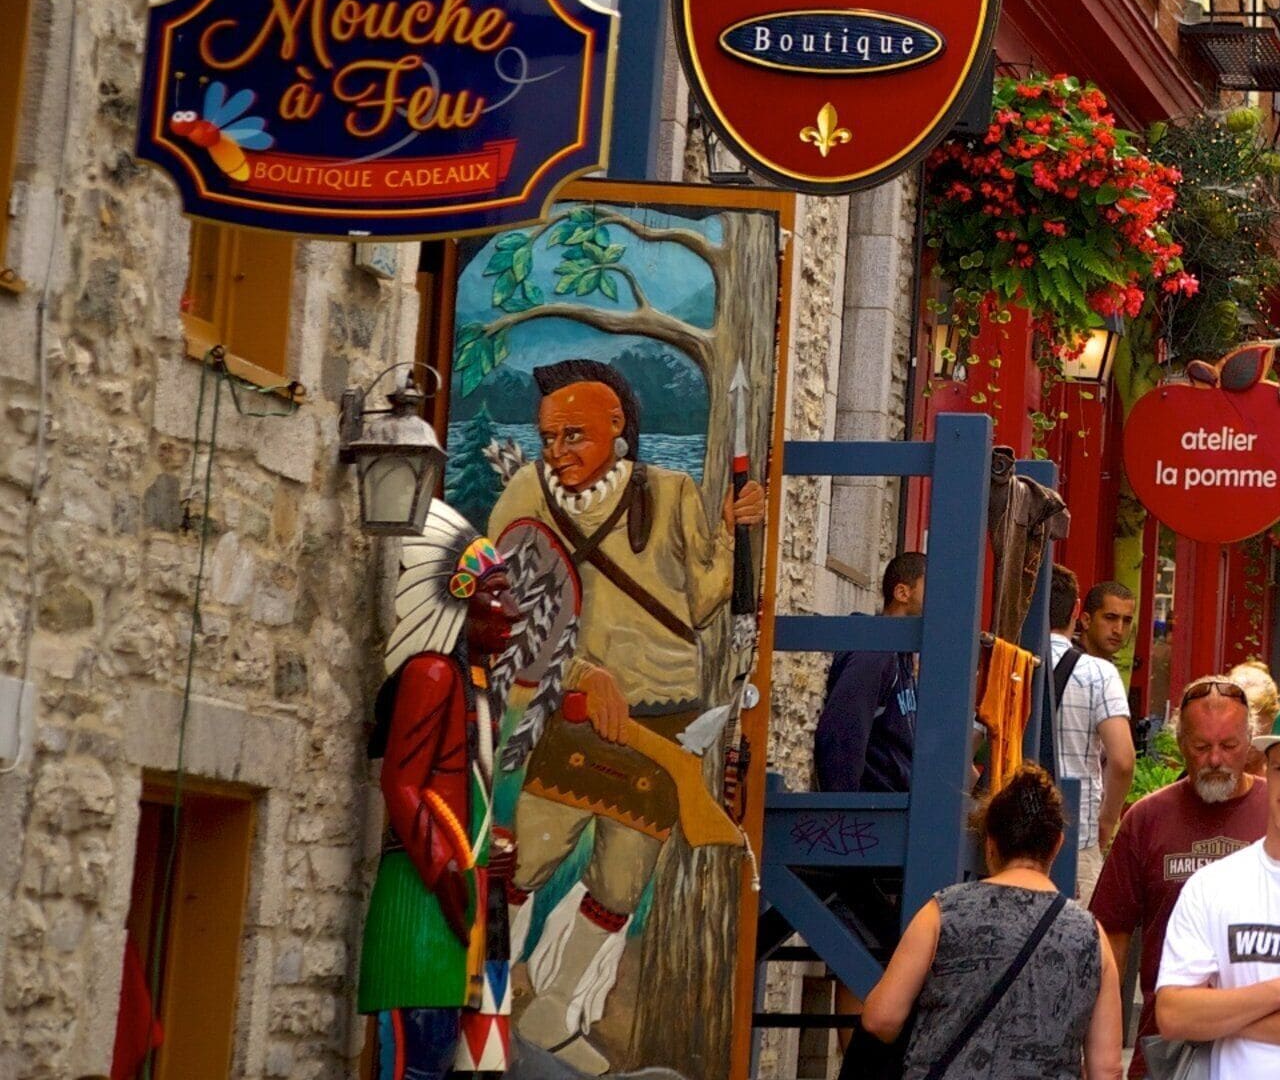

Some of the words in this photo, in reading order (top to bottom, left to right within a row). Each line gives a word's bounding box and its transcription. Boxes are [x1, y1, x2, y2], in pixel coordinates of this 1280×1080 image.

[753, 26, 914, 61] Boutique
[278, 66, 323, 120] à
[332, 54, 485, 138] Feu
[253, 161, 373, 190] BOUTIQUE
[384, 163, 491, 188] CADEAUX
[1181, 425, 1258, 451] atelier
[1155, 460, 1178, 485] la
[1184, 467, 1277, 490] pomme
